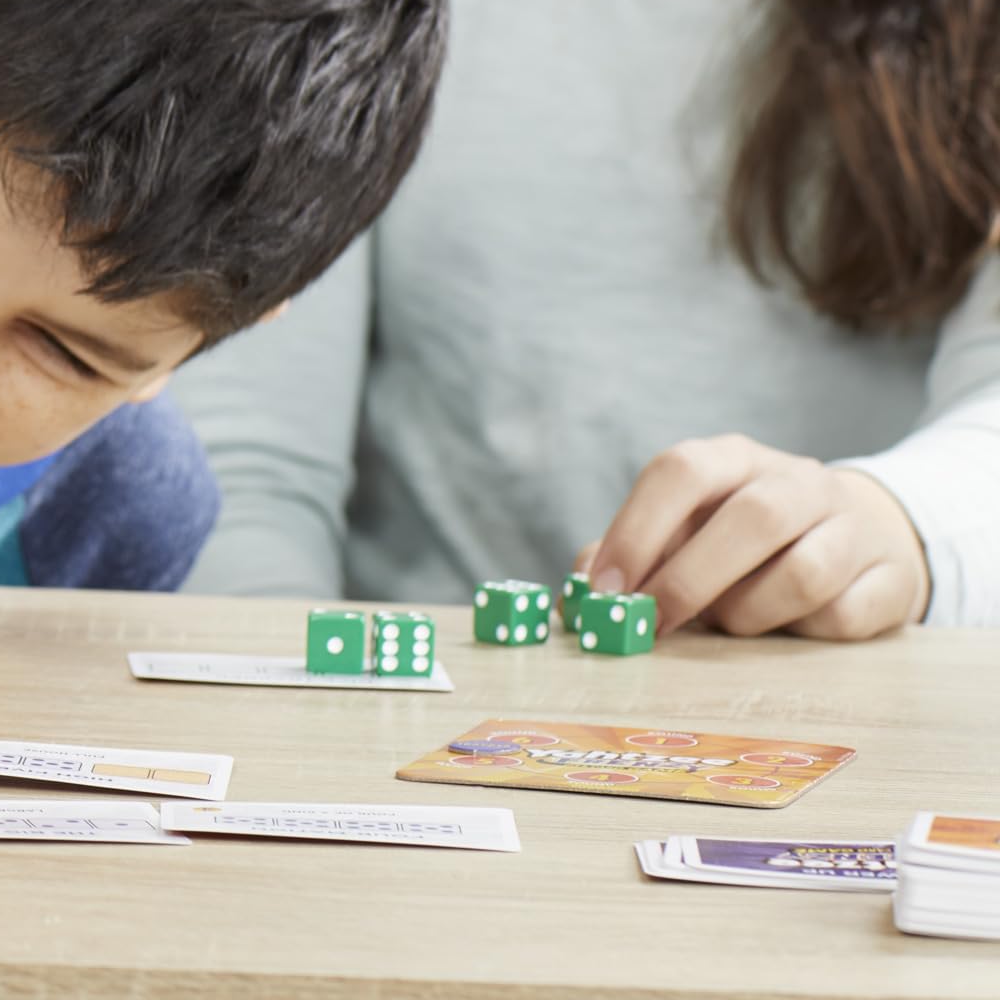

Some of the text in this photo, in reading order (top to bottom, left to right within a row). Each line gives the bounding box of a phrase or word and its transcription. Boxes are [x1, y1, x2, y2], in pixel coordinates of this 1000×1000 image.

[523, 748, 738, 767] Yahtzee
[801, 868, 897, 879] WER UP
